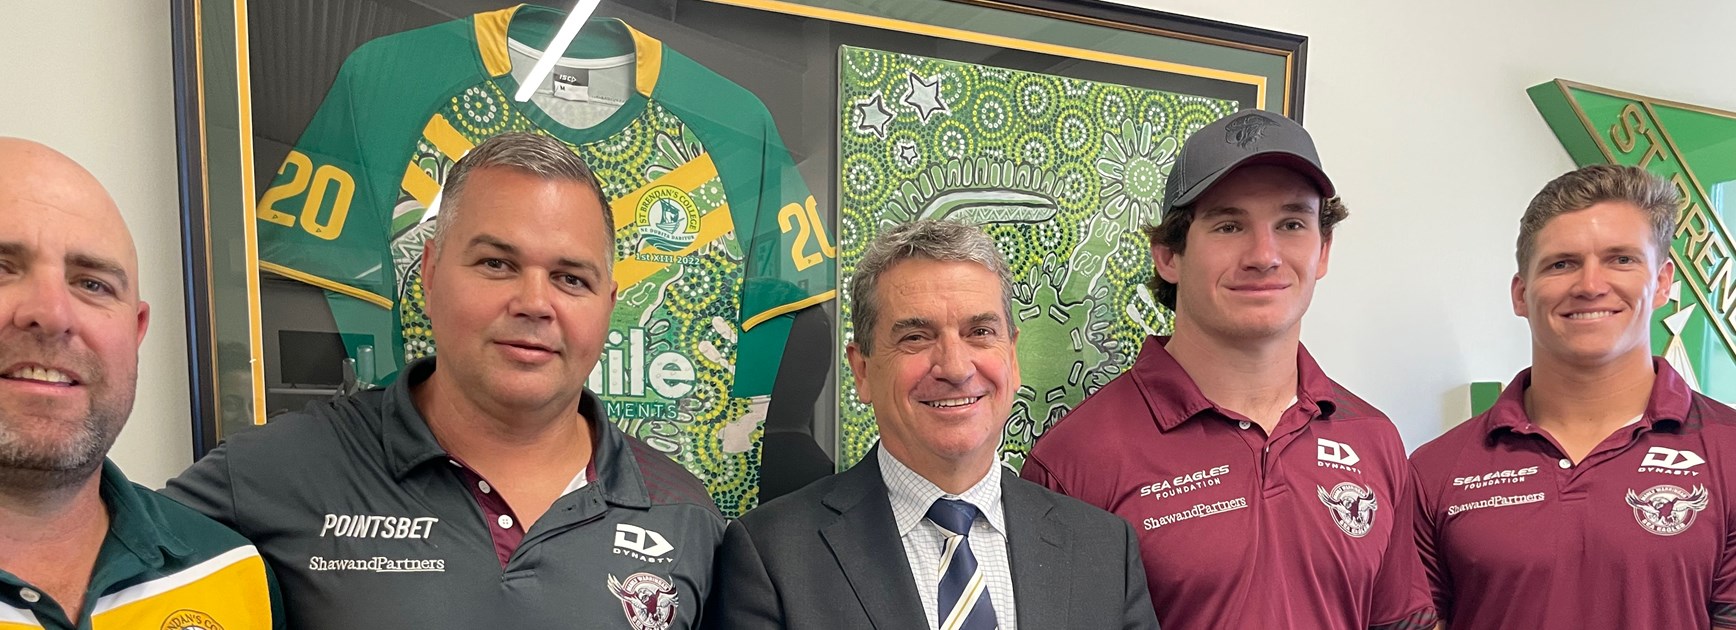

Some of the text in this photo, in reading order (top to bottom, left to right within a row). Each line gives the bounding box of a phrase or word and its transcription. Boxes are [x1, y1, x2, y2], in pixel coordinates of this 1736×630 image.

[256, 150, 356, 240] 20
[640, 189, 697, 230] ST BRENDAN'S COLLEGE
[1610, 103, 1736, 333] ST BREN
[636, 253, 700, 265] 1st XIII 2022
[1317, 460, 1362, 475] DYNASTY
[1453, 466, 1539, 486] SEA EAGLES
[1637, 467, 1699, 477] DYNASTY
[1141, 464, 1230, 497] SEA EAGLES
[1155, 477, 1221, 500] FOUNDATION
[1463, 476, 1526, 491] FOUNDATION
[1143, 497, 1248, 531] ShawandPartners
[1447, 492, 1545, 516] ShawandPartners
[320, 513, 439, 539] POINTSBET
[309, 556, 446, 573] ShawandPartners
[612, 547, 674, 564] DYNASTY
